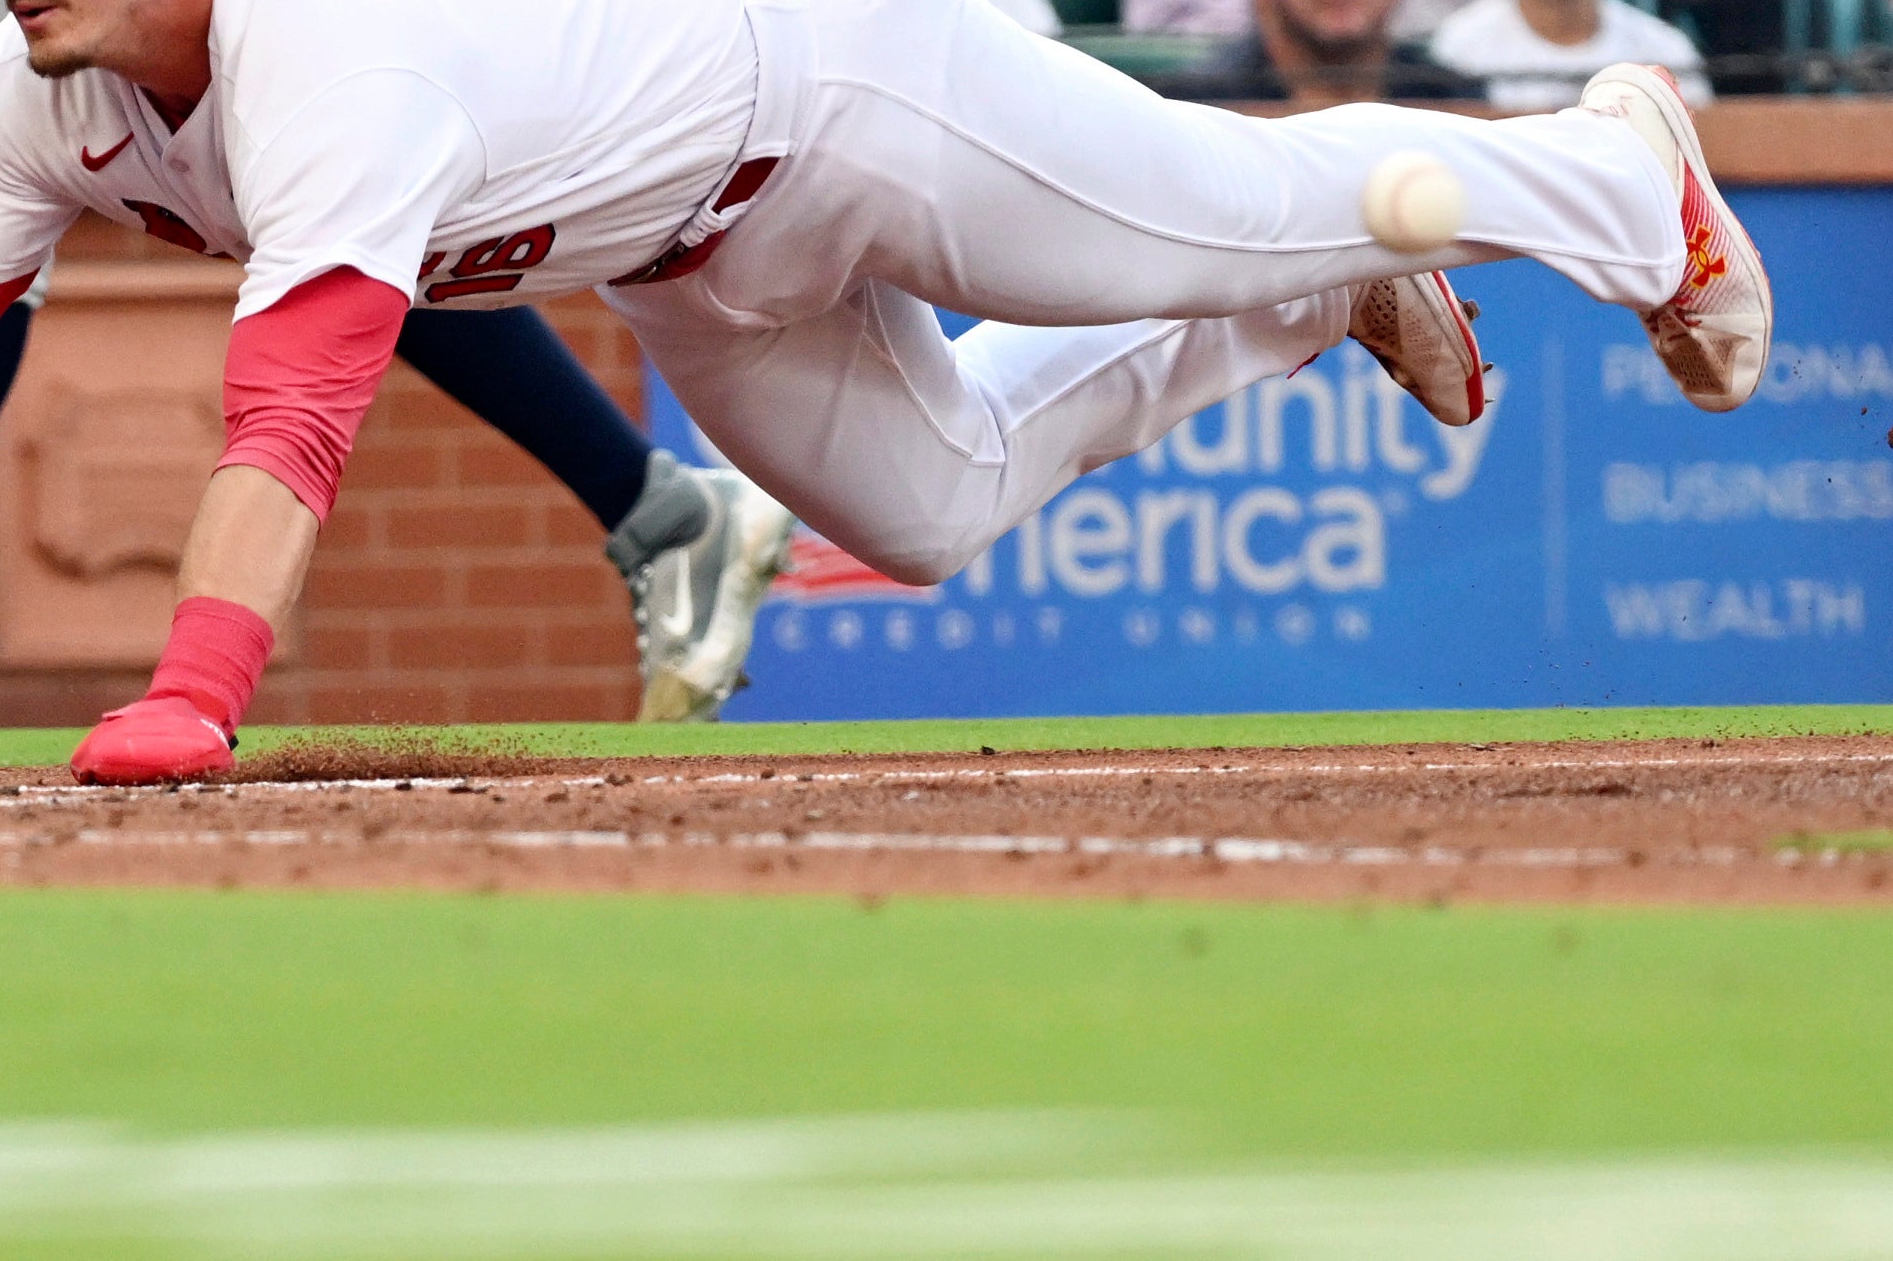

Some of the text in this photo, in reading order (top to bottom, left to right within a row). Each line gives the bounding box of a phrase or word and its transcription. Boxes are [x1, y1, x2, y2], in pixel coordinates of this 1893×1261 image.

[424, 222, 556, 304] 16
[1138, 338, 1505, 500] unity
[773, 605, 1371, 652] CREDIT UNION
[1606, 578, 1865, 641] WEALTH
